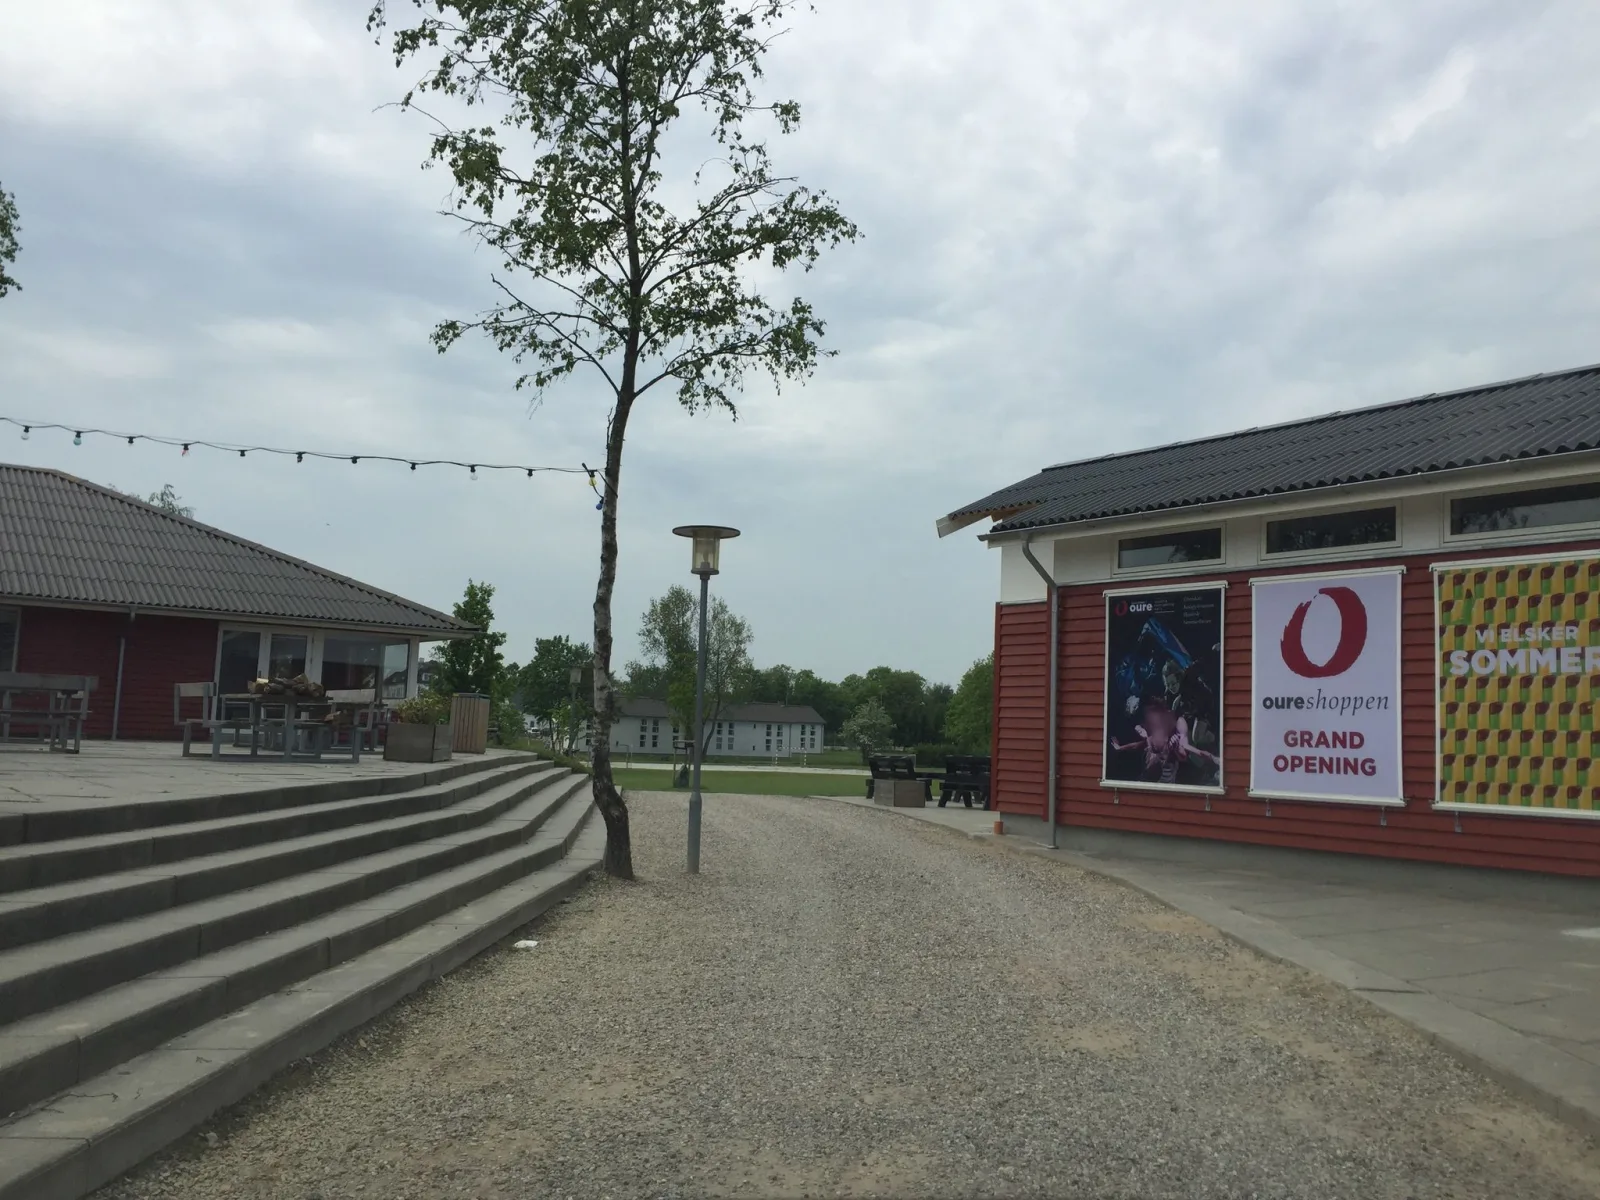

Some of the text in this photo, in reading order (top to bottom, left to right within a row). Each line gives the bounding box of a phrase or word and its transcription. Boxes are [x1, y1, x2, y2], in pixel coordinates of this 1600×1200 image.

[1129, 603, 1153, 612] oure
[1476, 626, 1578, 643] VI ELSKER
[1450, 646, 1600, 675] SOMMER
[1283, 730, 1365, 749] GRAND
[1273, 754, 1377, 776] OPENING
